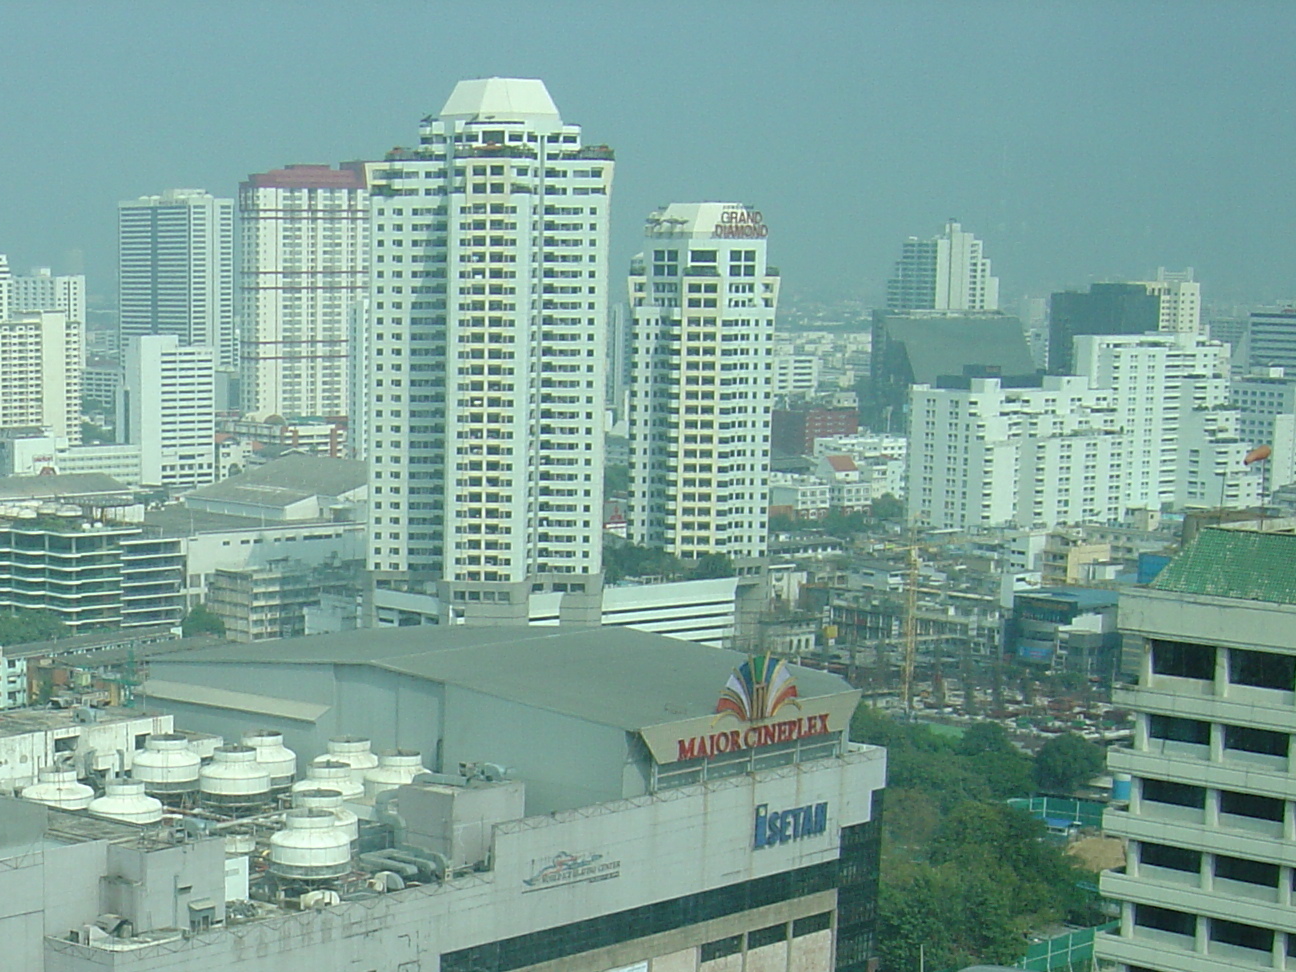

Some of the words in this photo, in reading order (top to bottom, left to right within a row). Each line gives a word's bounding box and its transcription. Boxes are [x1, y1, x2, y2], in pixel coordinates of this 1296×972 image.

[721, 211, 763, 224] GRAND
[715, 224, 768, 237] DIAMOND
[678, 730, 741, 760] MAJOR
[743, 713, 829, 748] CINEPLEX
